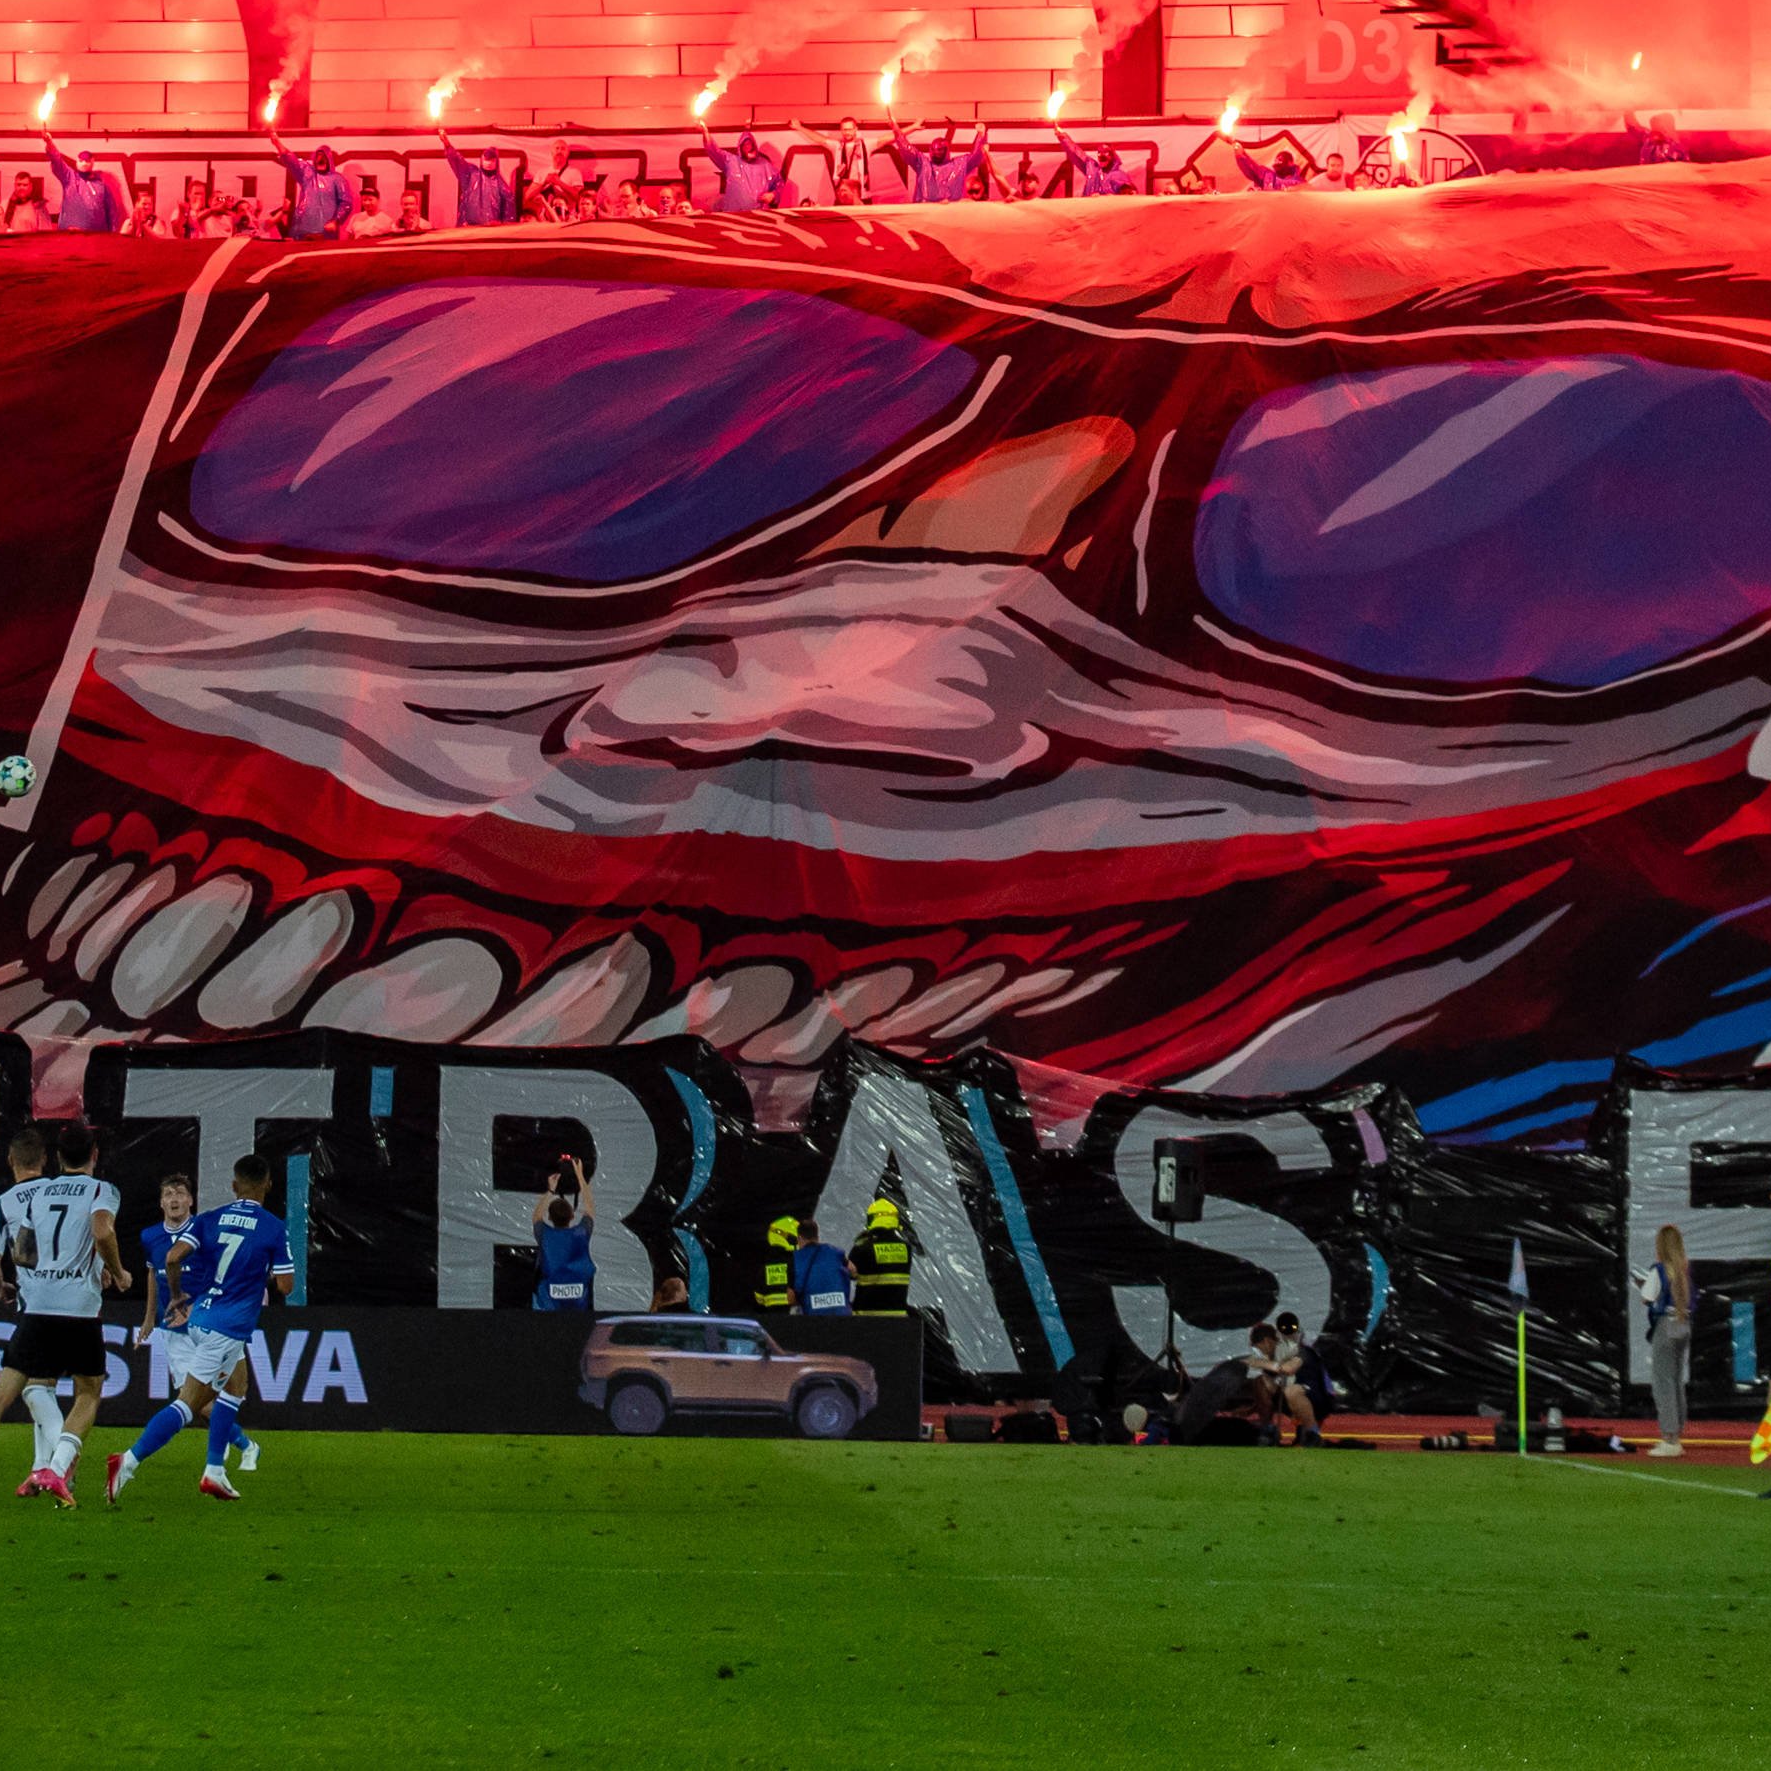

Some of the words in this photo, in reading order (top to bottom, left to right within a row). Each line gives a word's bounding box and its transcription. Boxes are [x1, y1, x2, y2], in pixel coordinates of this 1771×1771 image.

[1305, 19, 1403, 85] D3
[49, 1203, 70, 1262] 7
[215, 1231, 245, 1285] 7
[552, 1285, 582, 1296] PHOTO
[814, 1293, 844, 1306] PHOTO
